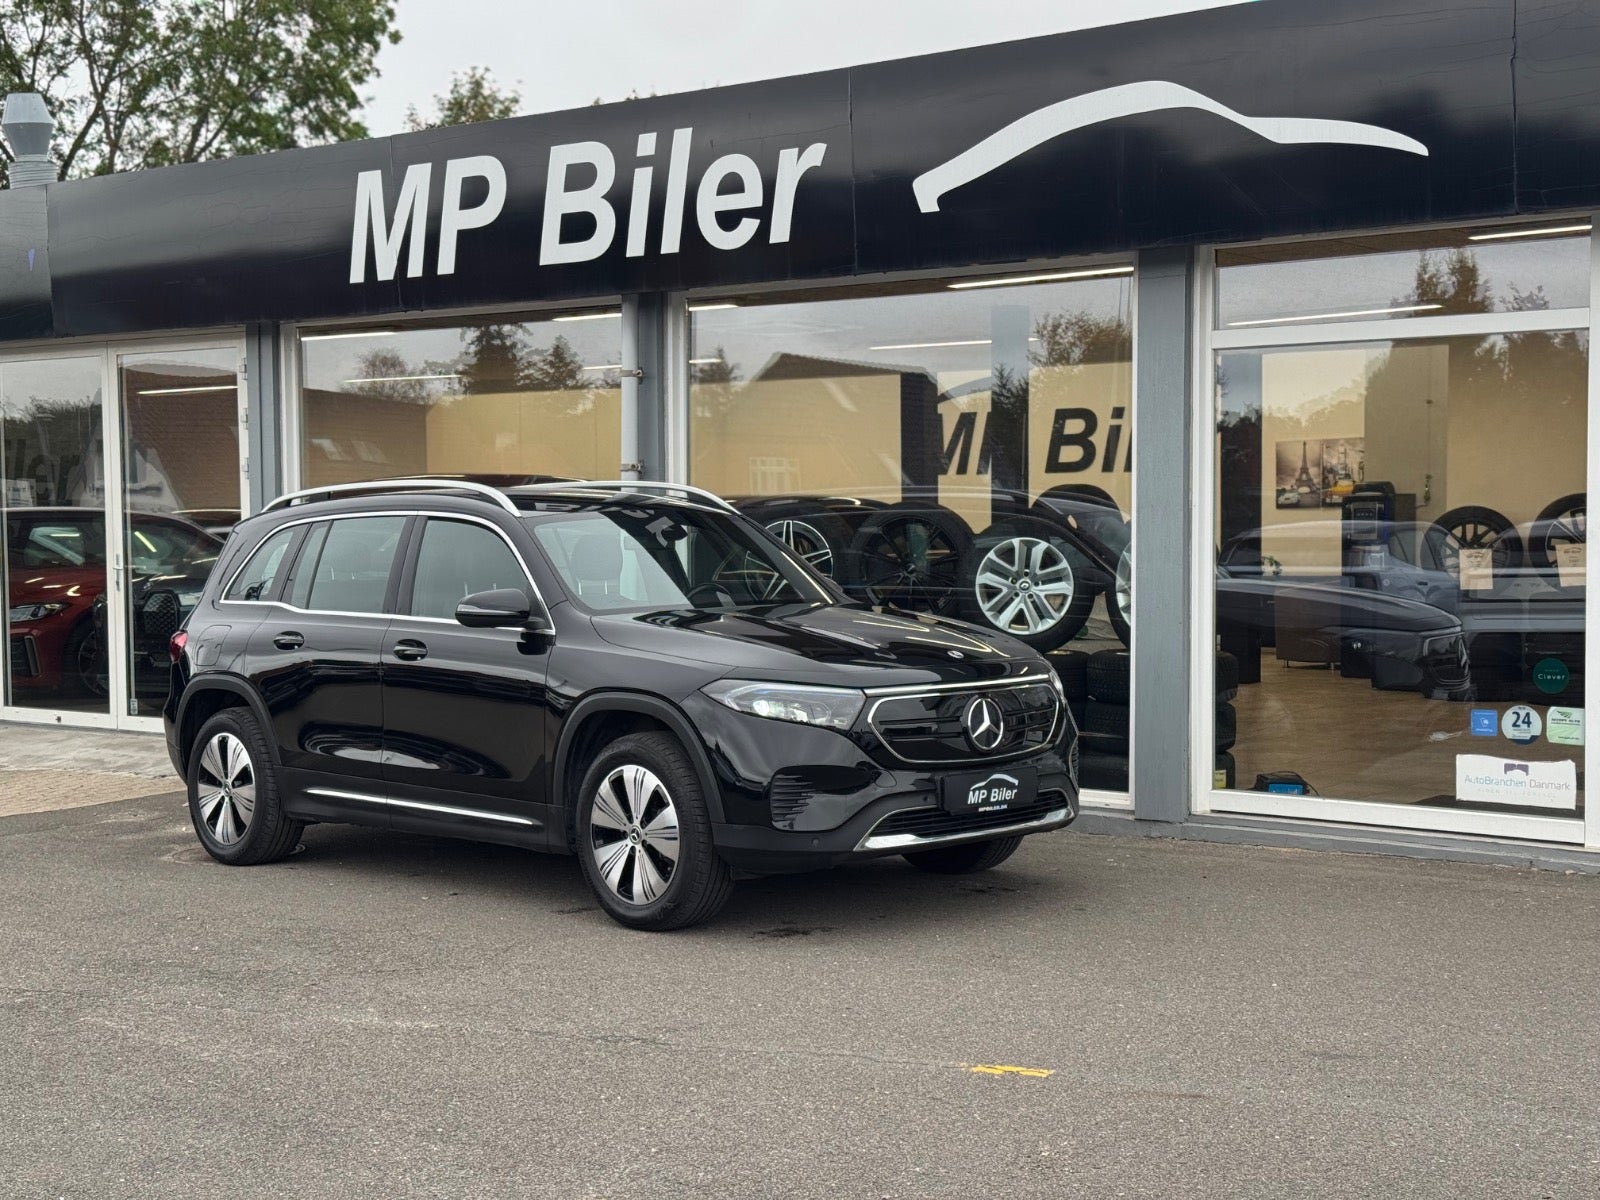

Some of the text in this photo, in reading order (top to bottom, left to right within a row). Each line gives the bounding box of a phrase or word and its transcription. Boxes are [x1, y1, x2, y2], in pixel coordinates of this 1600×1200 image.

[350, 127, 827, 283] MP Biler
[1045, 407, 1132, 474] Bi
[1511, 711, 1532, 729] 24
[1465, 775, 1570, 790] AutoBranchen Danmark
[968, 788, 1017, 804] MP Biler
